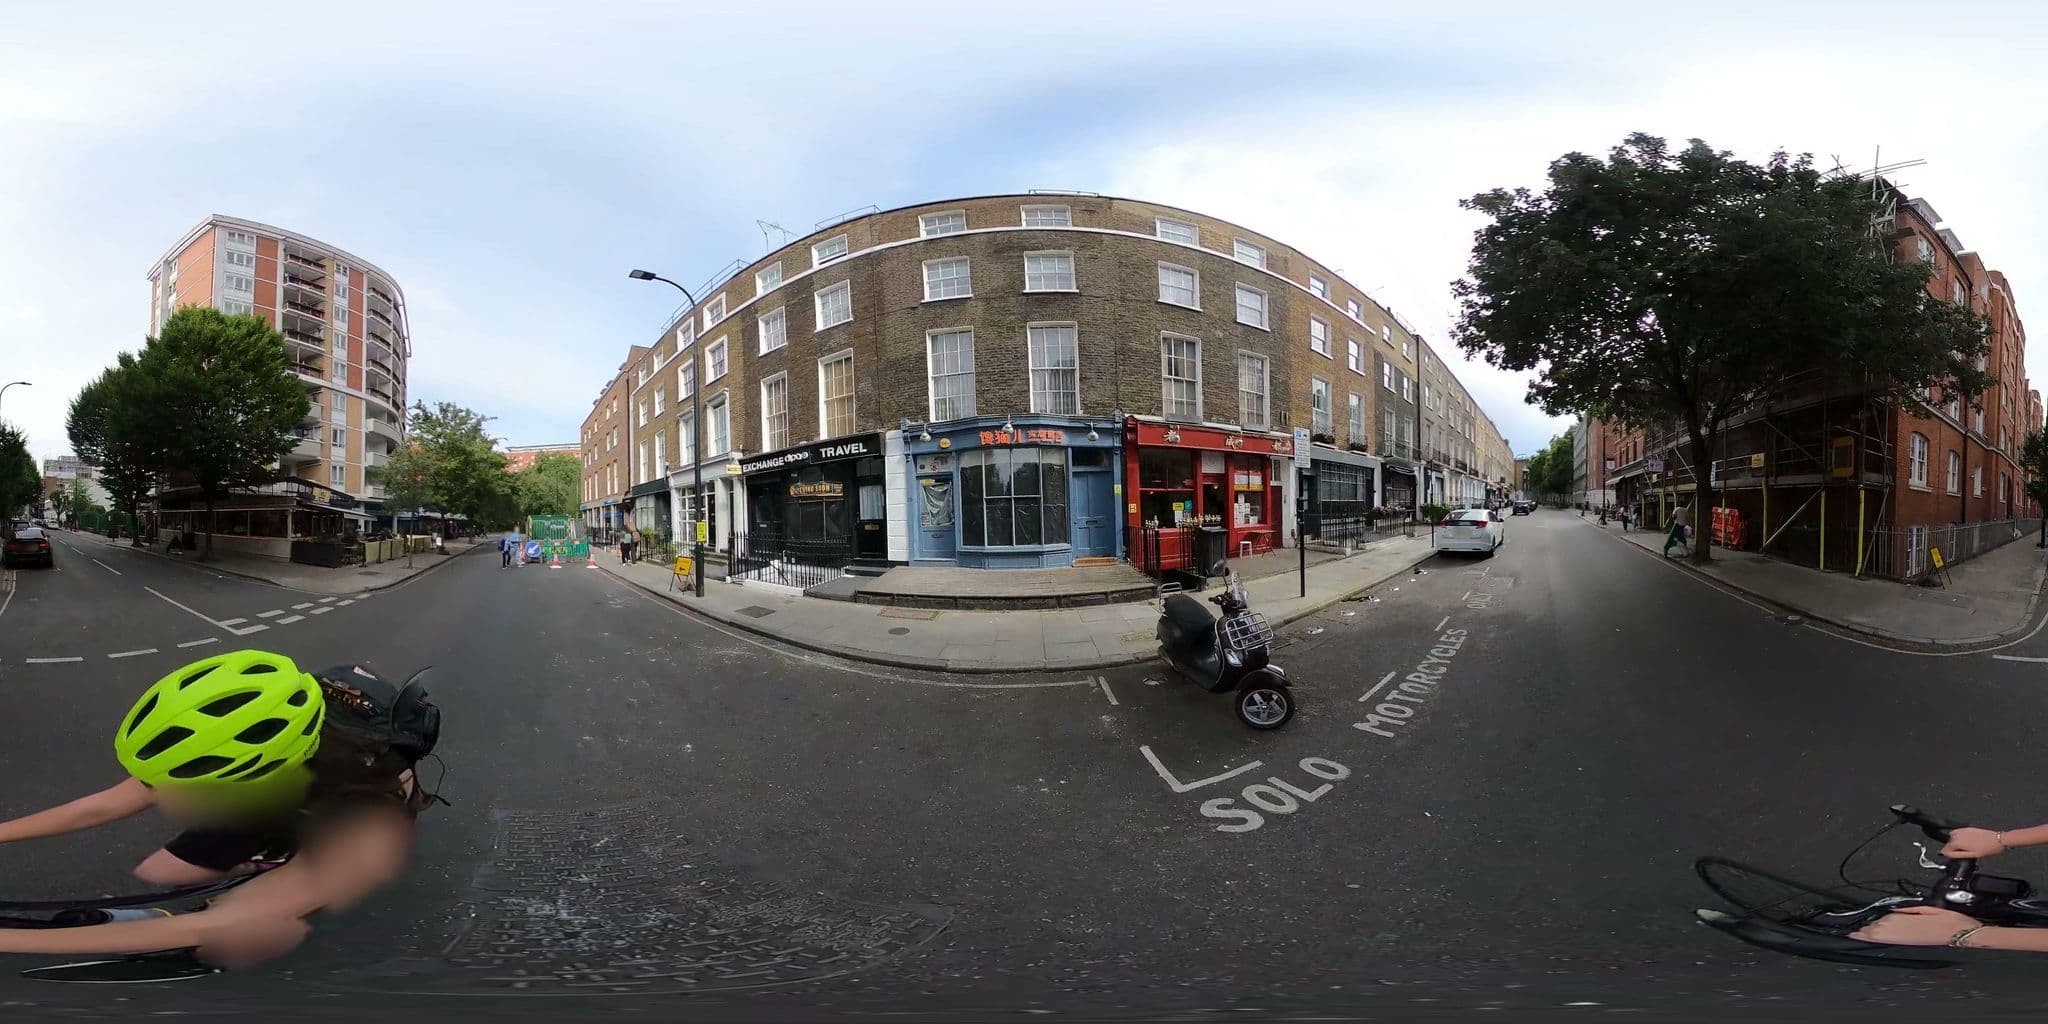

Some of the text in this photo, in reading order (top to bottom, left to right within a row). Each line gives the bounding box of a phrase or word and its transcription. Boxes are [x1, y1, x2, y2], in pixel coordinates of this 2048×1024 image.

[743, 456, 785, 472] EXCHANGE
[820, 443, 867, 459] TRAVEL
[1352, 628, 1468, 738] MOTORCYCLES
[1200, 756, 1351, 833] SOLO
